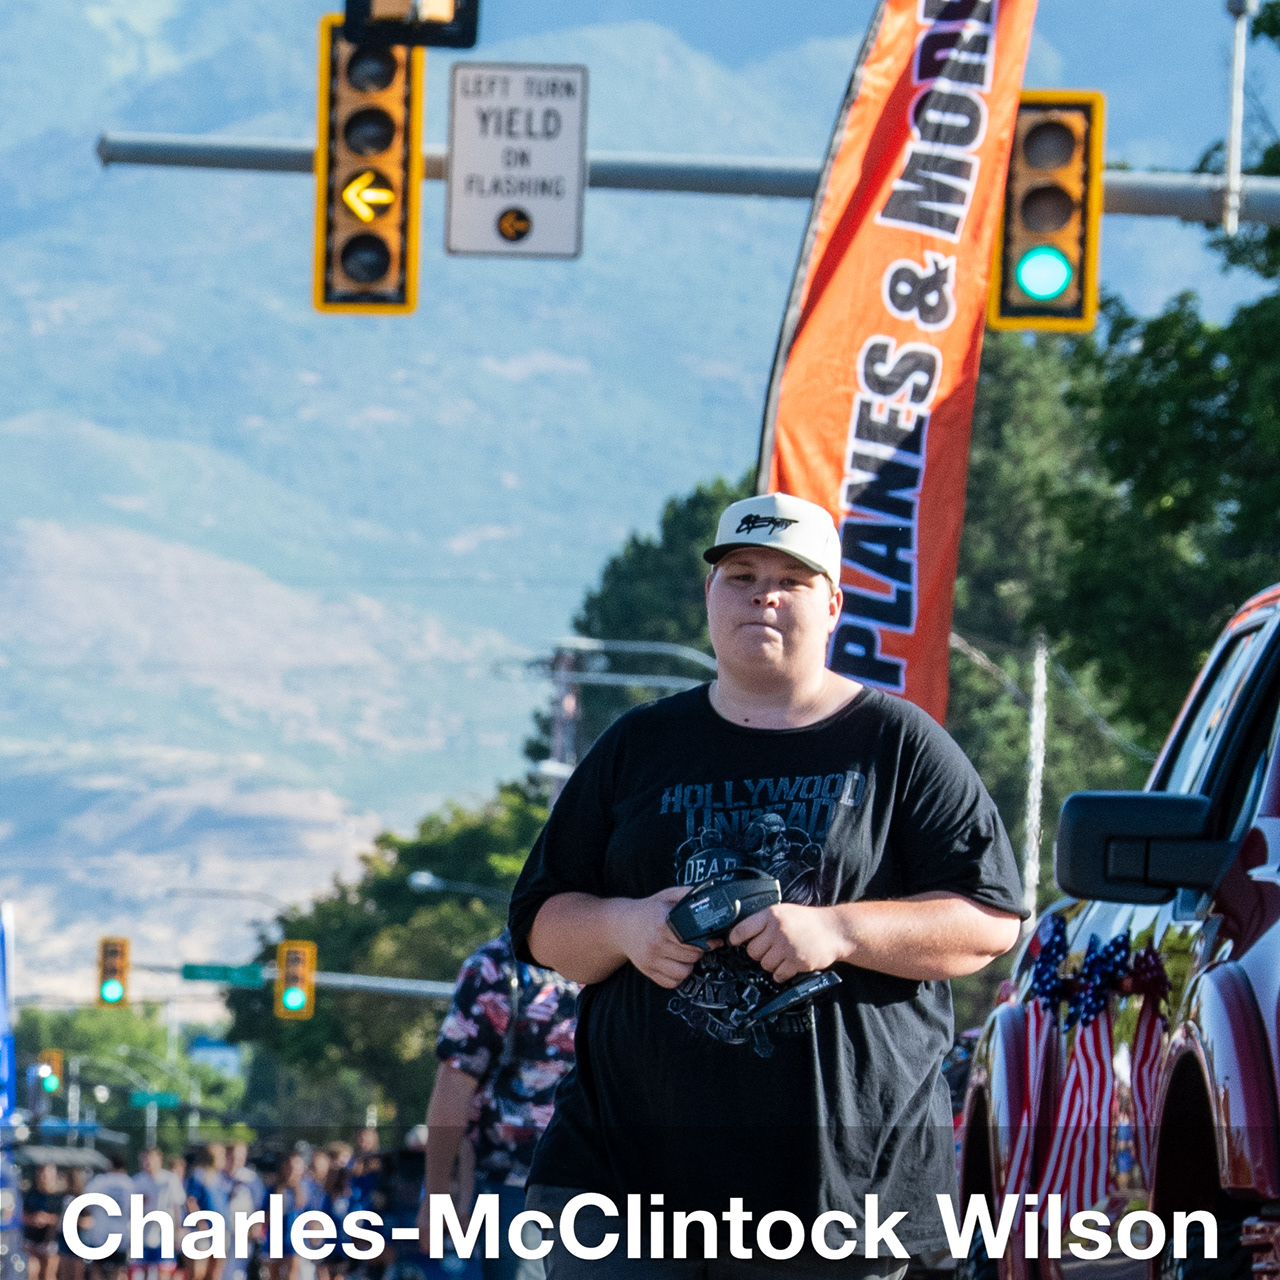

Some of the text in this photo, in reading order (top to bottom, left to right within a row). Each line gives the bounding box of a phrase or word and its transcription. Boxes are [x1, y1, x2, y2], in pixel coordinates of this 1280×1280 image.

[461, 75, 577, 98] LEFT TURN
[476, 105, 562, 140] YIELD
[501, 146, 532, 168] ON
[464, 173, 566, 198] FLASHING
[881, 250, 956, 332] &
[826, 334, 942, 693] PLANES
[660, 769, 866, 815] HOLLYWOOD
